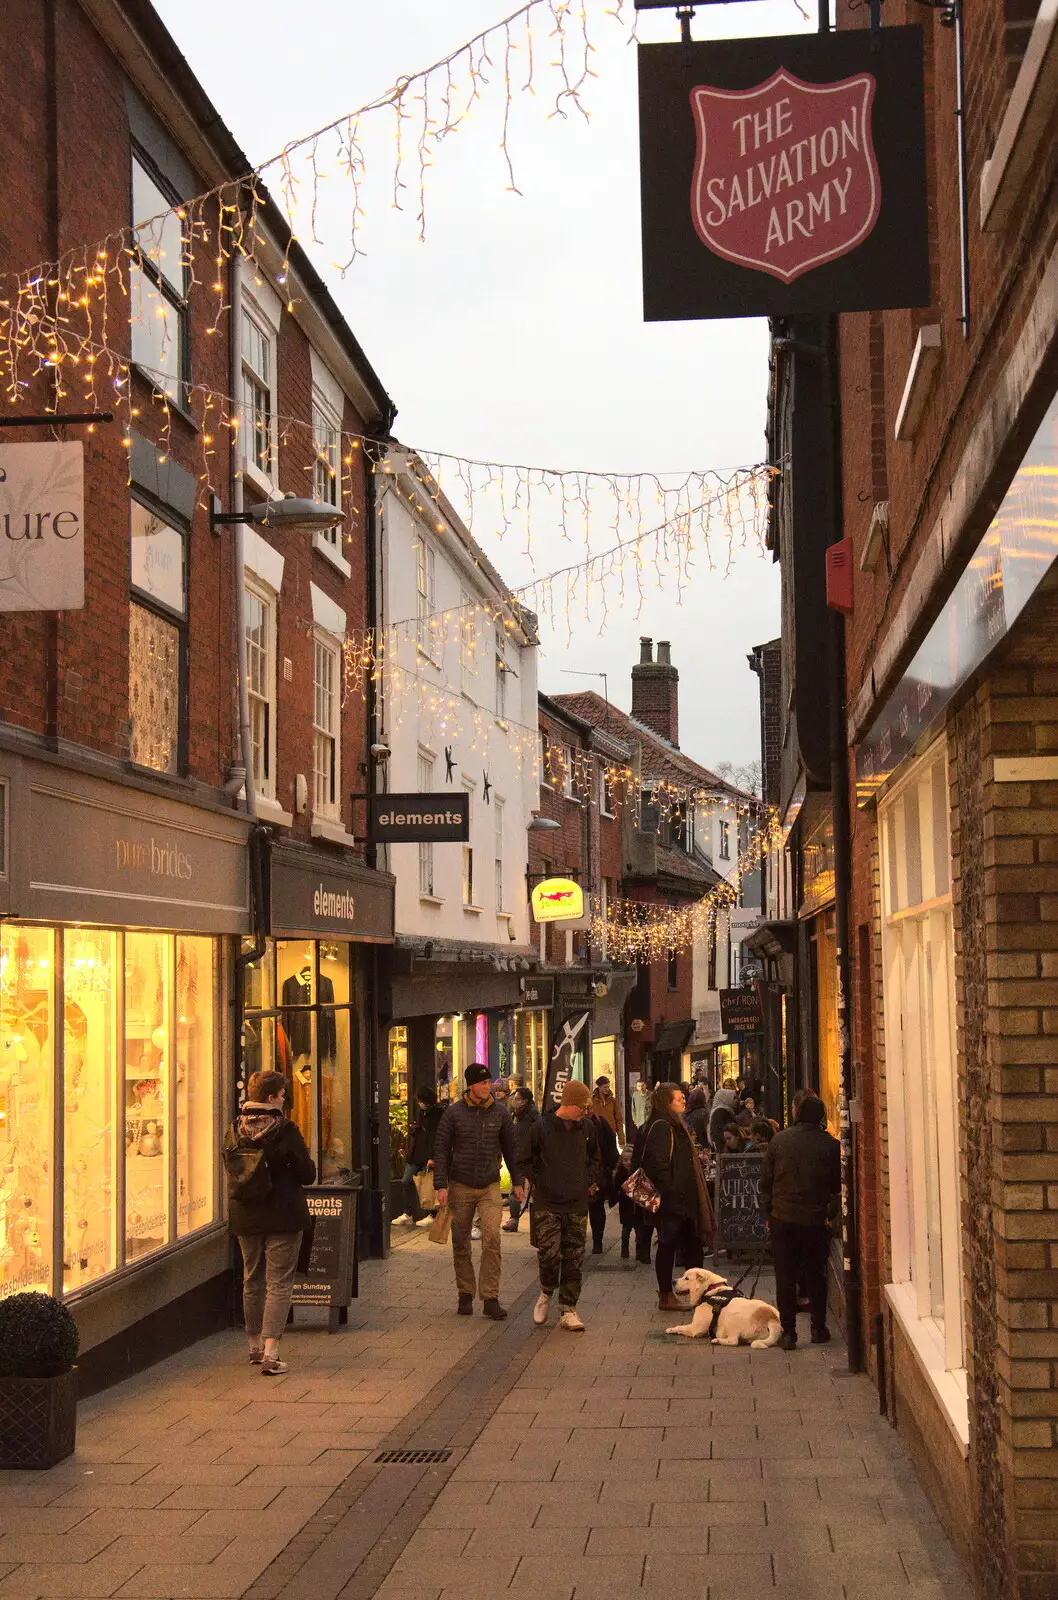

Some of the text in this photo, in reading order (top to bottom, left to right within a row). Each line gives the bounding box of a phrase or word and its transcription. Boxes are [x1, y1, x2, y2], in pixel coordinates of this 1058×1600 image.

[732, 98, 793, 157] THE
[706, 105, 860, 228] SALVATION
[764, 166, 852, 254] ARMY
[0, 510, 80, 541] ure
[378, 810, 463, 826] elements
[313, 883, 355, 920] elements
[306, 1198, 342, 1208] ments
[309, 1208, 342, 1216] swear
[303, 1284, 331, 1292] Sundays
